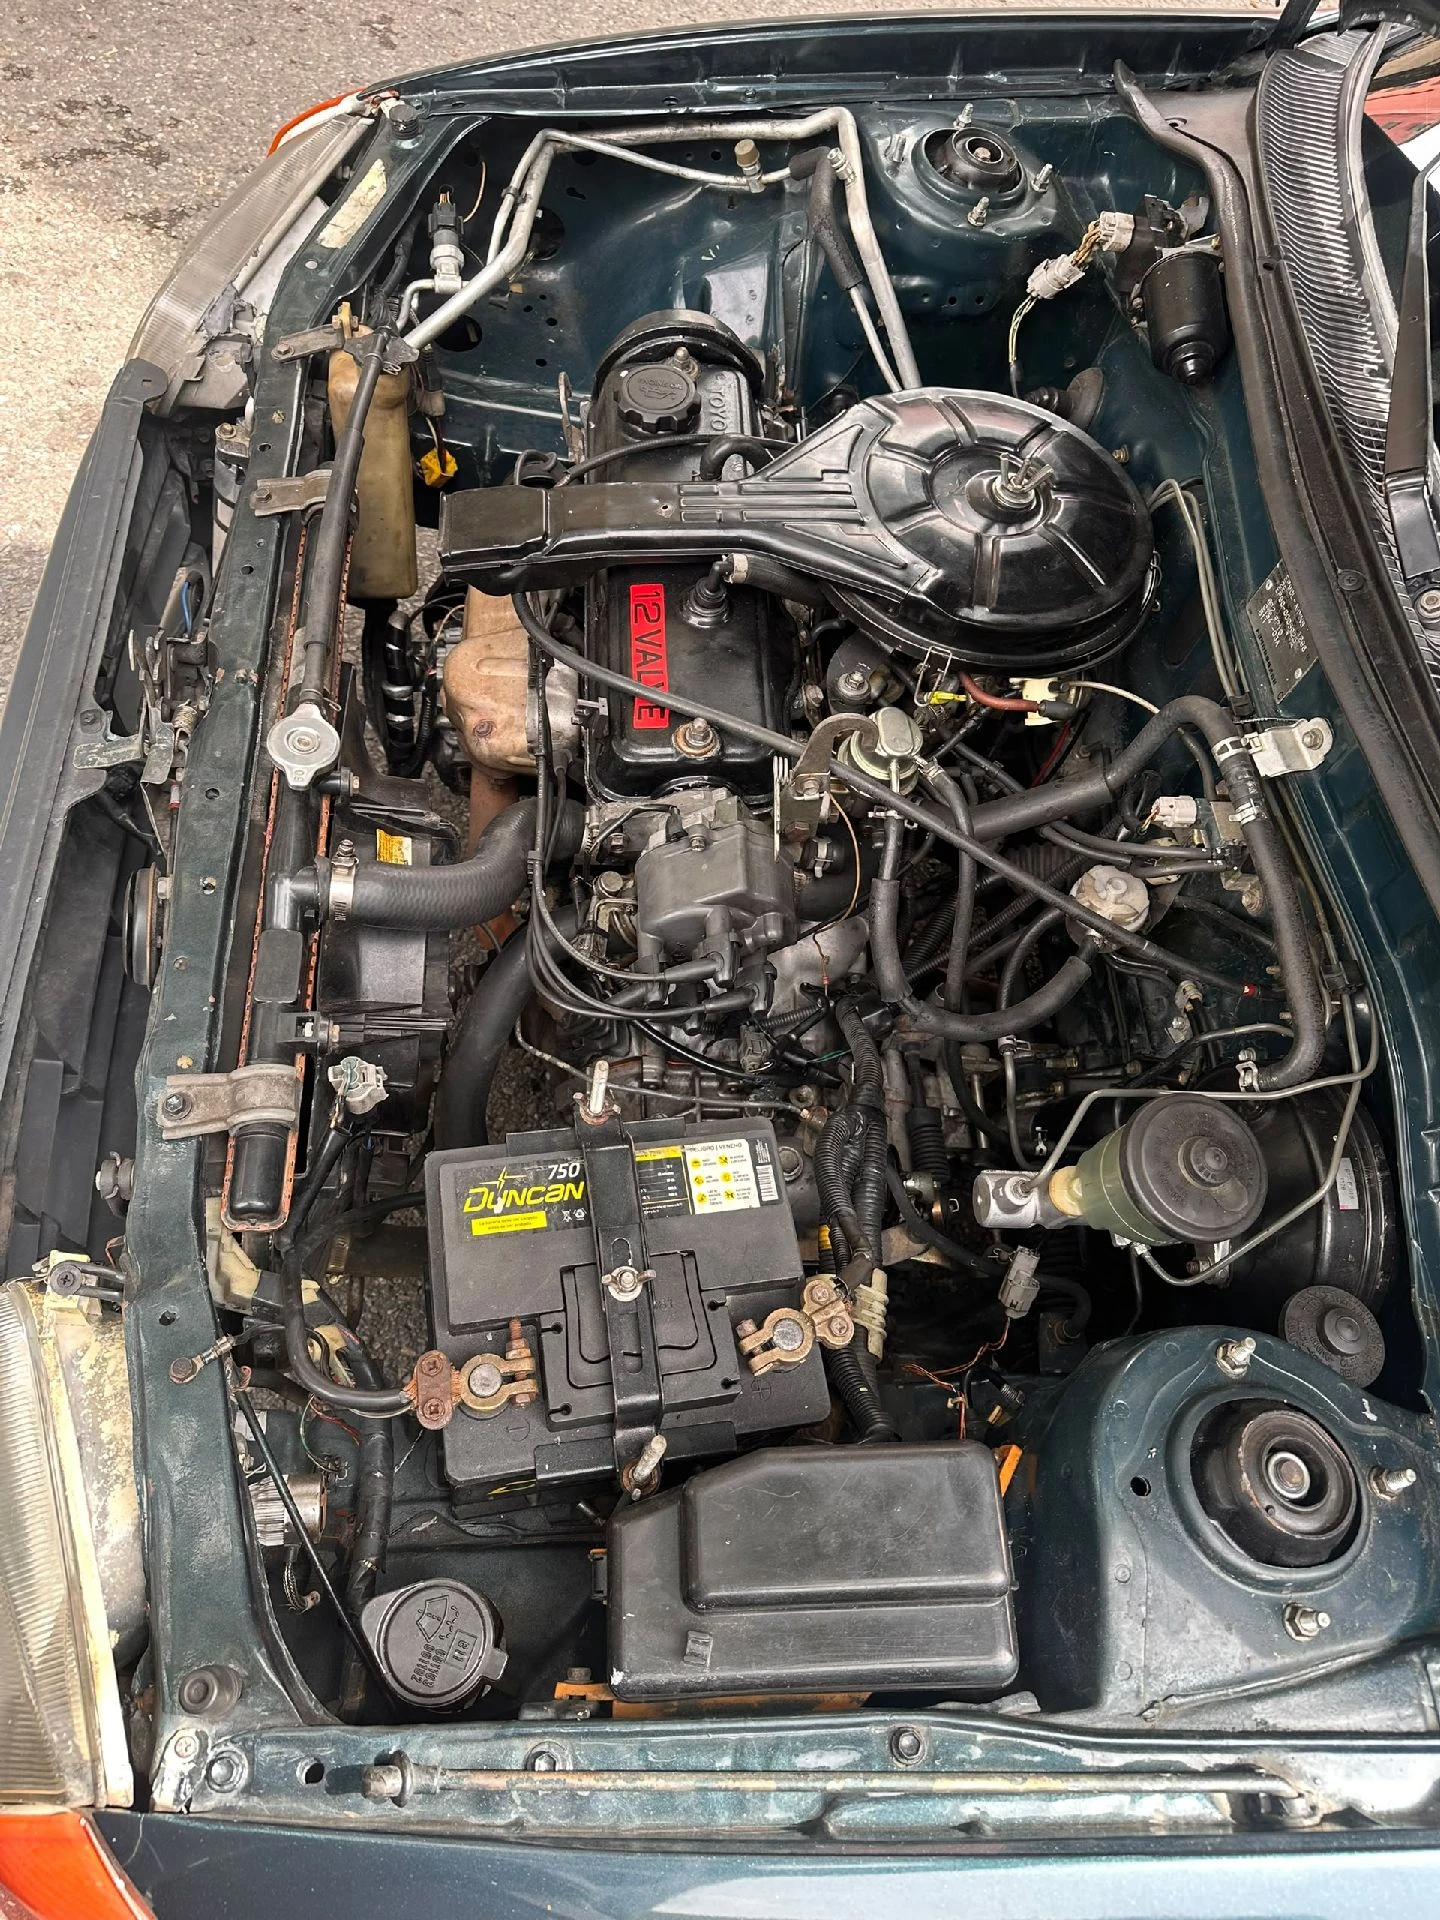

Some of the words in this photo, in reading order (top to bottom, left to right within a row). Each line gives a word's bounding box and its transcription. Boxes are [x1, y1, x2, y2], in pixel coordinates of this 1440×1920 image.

[709, 390, 728, 432] TOYO
[634, 591, 661, 624] 12
[547, 1162, 581, 1180] 750
